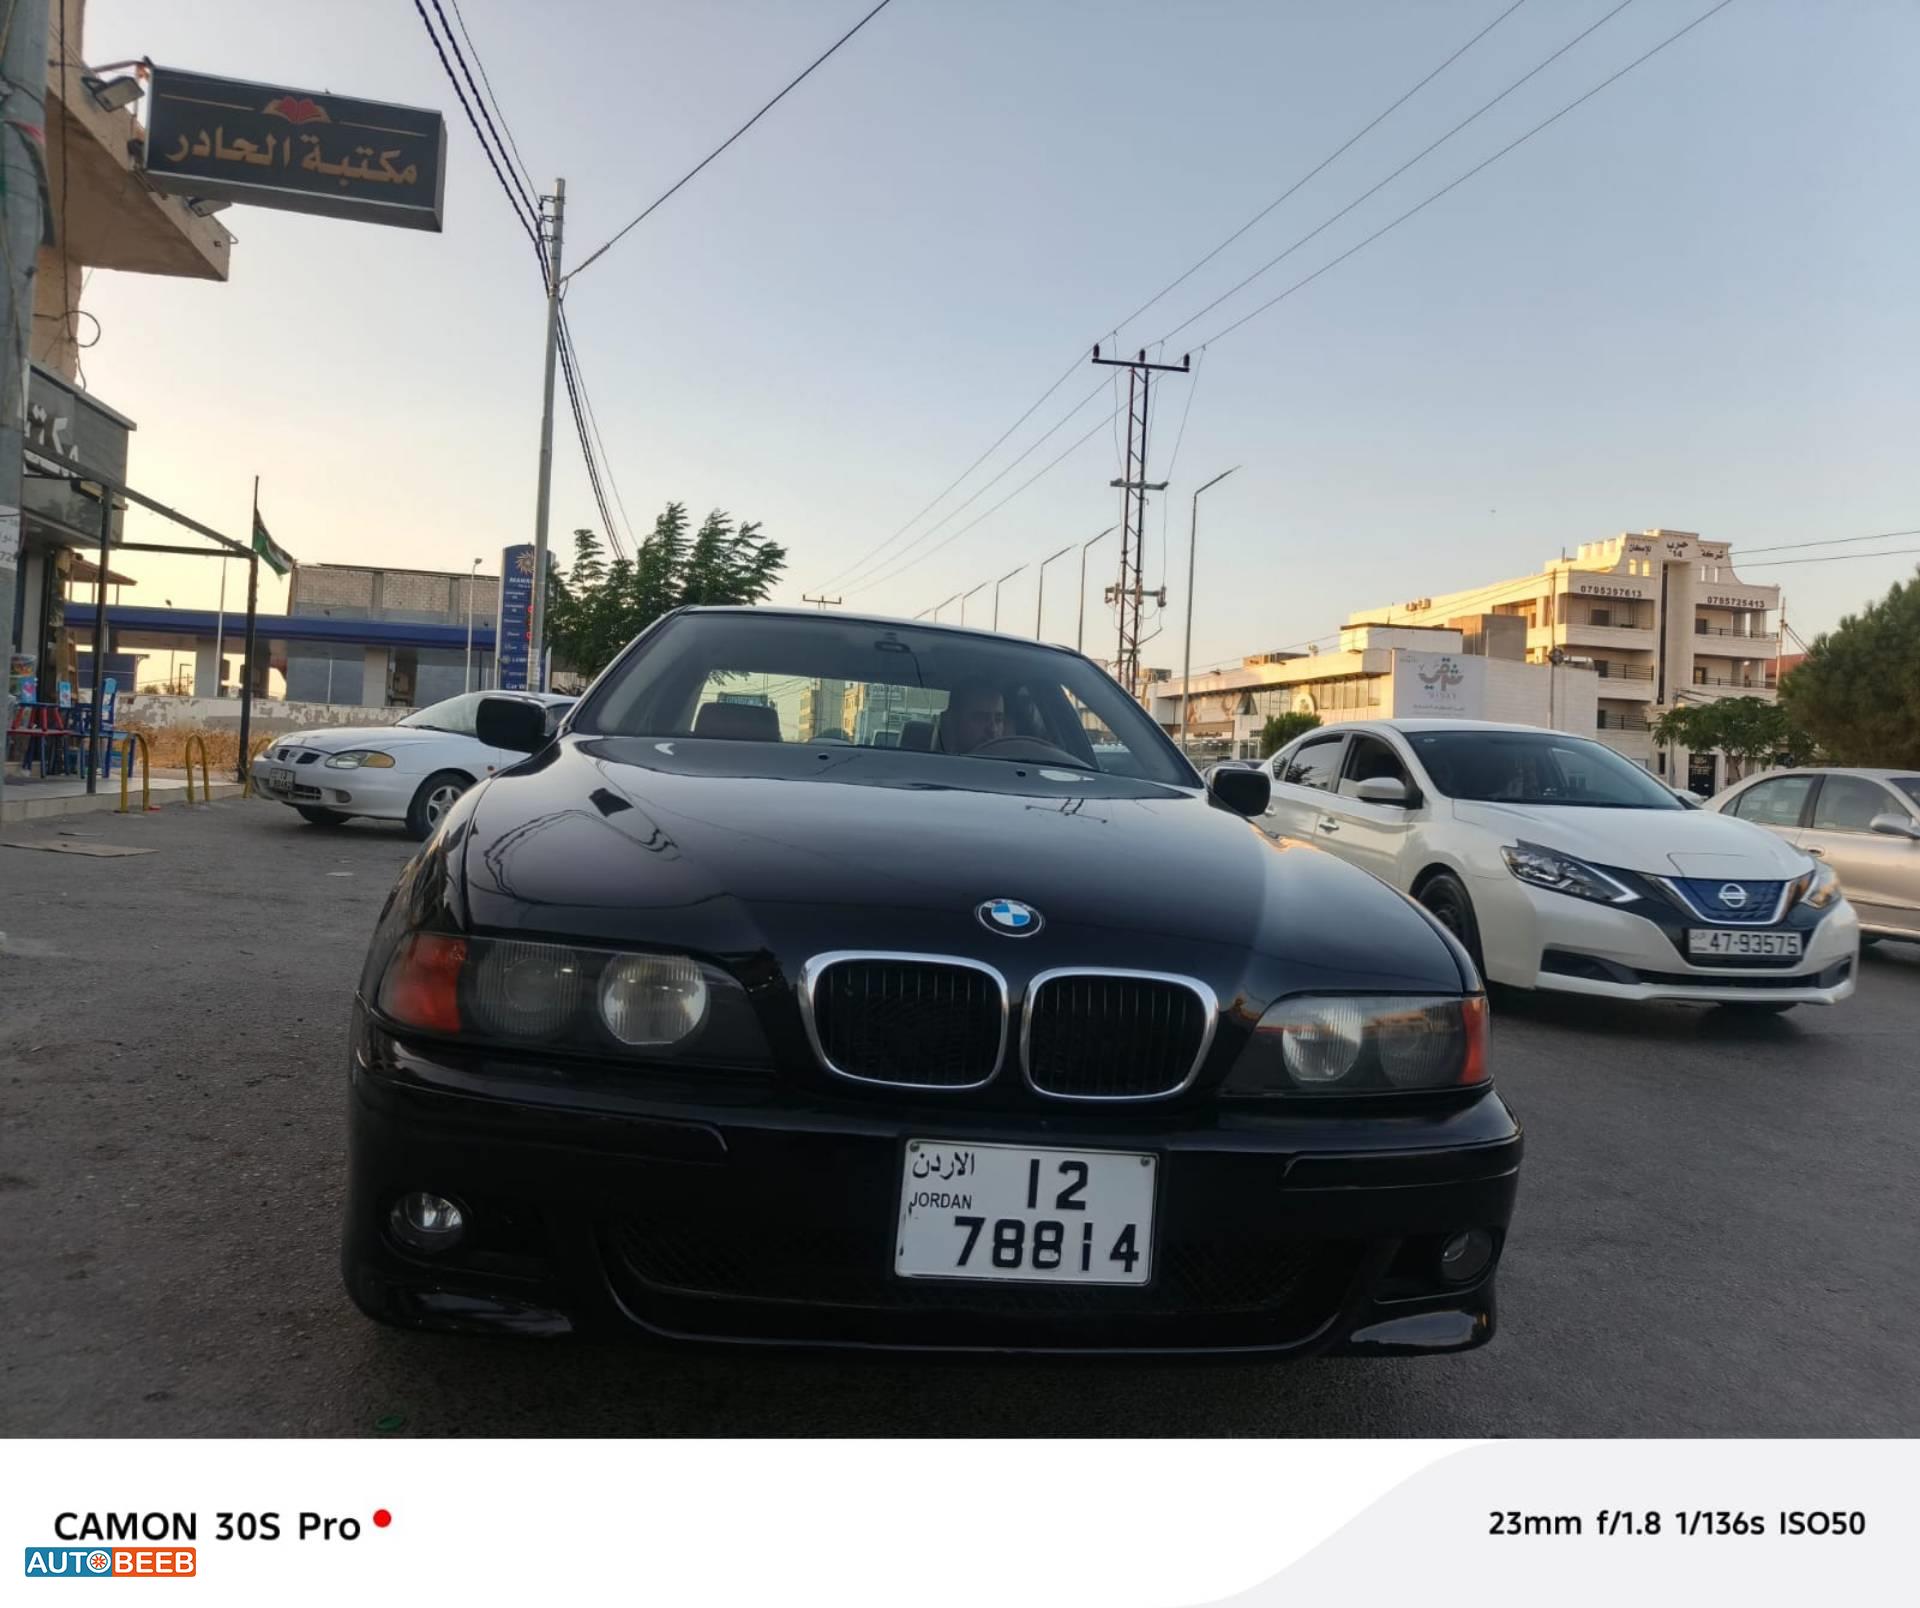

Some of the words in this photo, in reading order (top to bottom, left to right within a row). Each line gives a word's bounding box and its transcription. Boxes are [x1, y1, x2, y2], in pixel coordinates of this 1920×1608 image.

[165, 125, 292, 169] الحادر
[301, 134, 417, 187] مكتبة
[1672, 550, 1683, 558] 14
[1709, 932, 1798, 955] 47-93575
[910, 1191, 972, 1210] JORDAN
[1027, 1158, 1089, 1211] 12
[954, 1215, 1140, 1273] 78814
